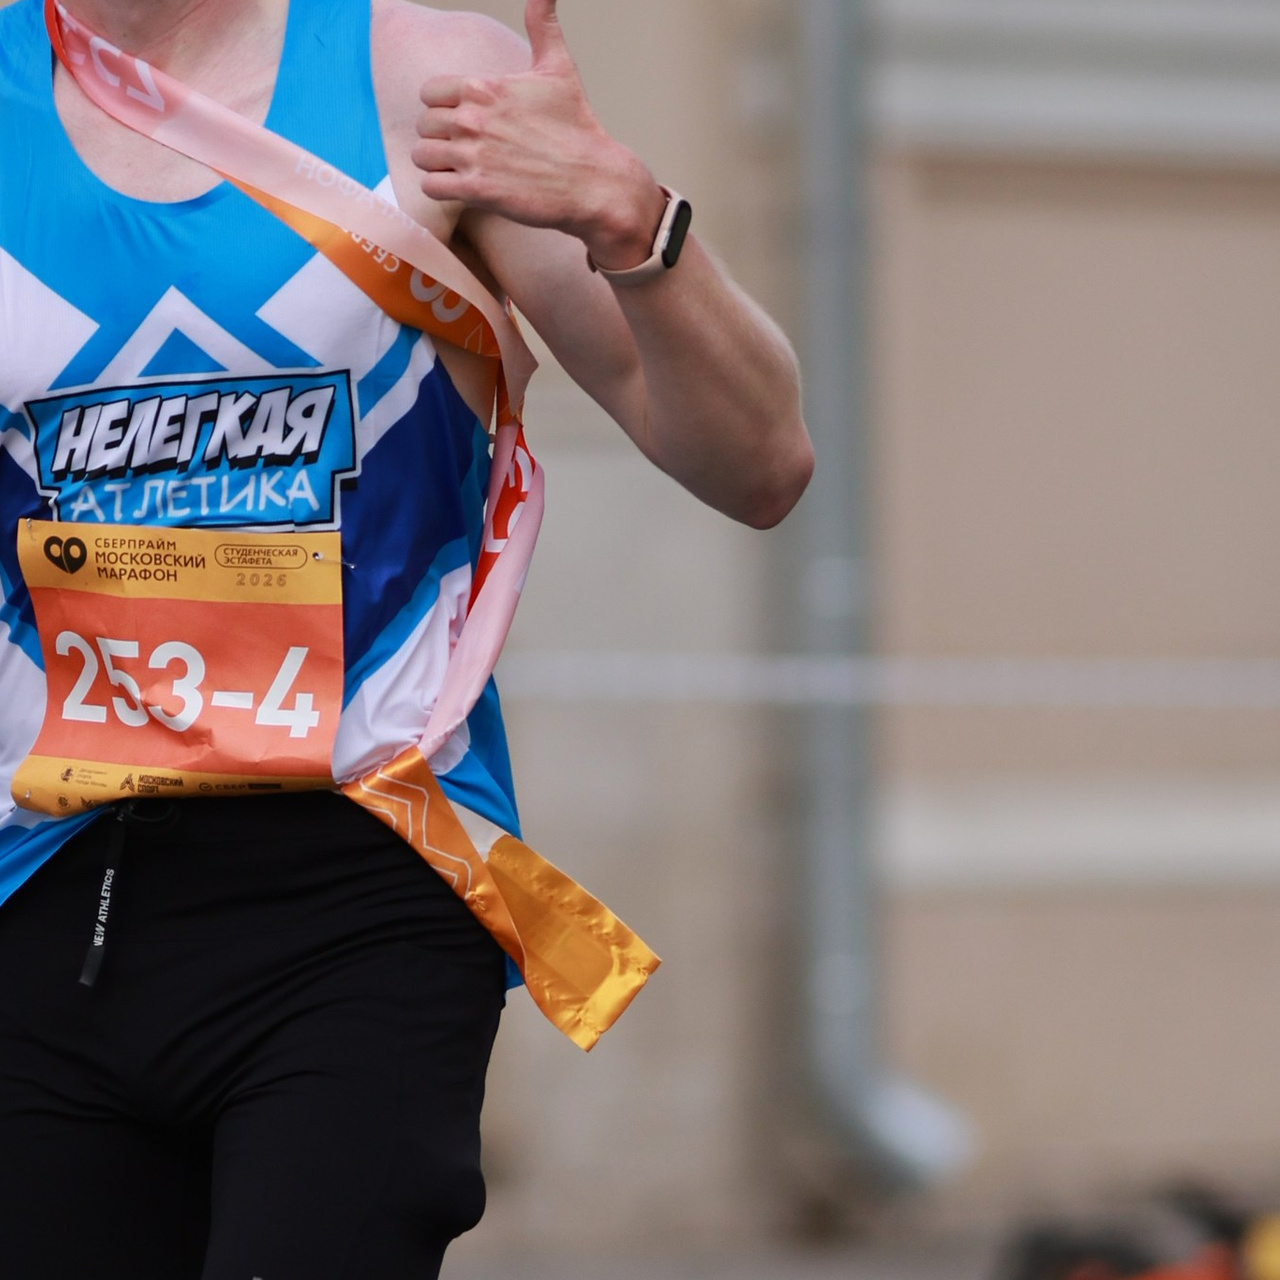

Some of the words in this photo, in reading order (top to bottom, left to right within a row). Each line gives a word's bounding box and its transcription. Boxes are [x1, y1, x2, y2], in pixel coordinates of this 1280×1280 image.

[51, 385, 335, 480] НЕЛЕГКАЯ
[94, 537, 177, 551] СБЕРПРАЙМ
[223, 547, 298, 557] СТУДЕНЧЕСКАЯ
[94, 551, 206, 569] МОСКОВСКИЙ
[223, 556, 273, 565] ЭСТАФЕТА
[97, 566, 178, 582] МАРАФОН
[235, 572, 287, 588] 2026
[55, 630, 320, 738] 253-4
[97, 868, 115, 923] ATHLETICS
